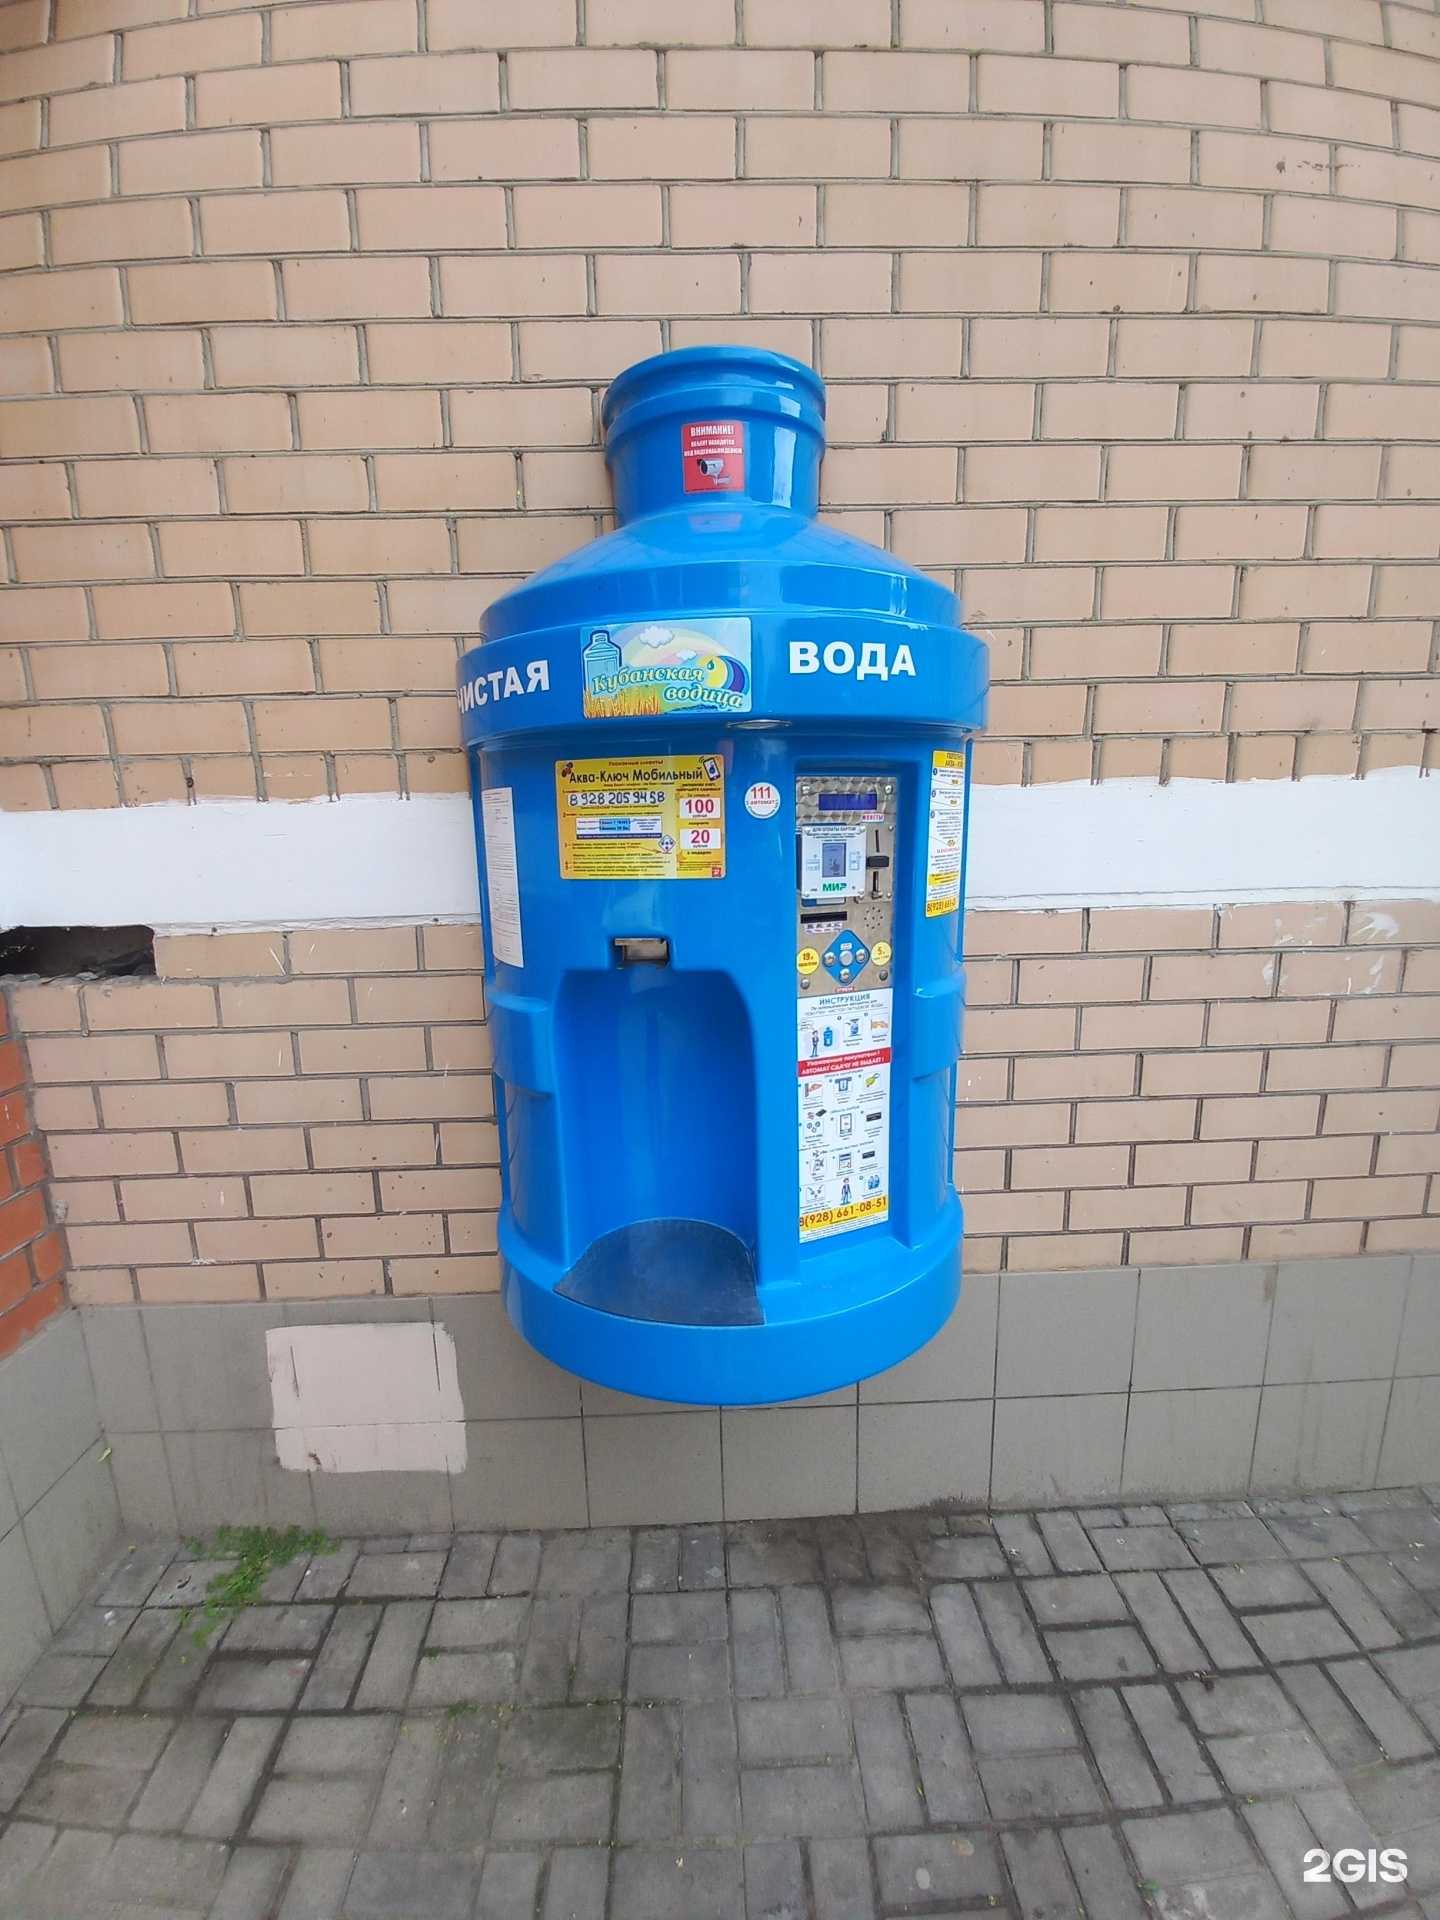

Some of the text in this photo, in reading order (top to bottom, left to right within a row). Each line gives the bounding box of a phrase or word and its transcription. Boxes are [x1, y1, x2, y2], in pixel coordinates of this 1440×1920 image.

[690, 425, 734, 437] ВНИМАНИЕ!
[789, 641, 917, 681] ВОДА
[592, 665, 705, 694] Кубанская
[664, 684, 744, 708] водица
[569, 766, 703, 784] Аква-Ключ Мобильный
[750, 786, 771, 799] 111
[685, 799, 714, 813] 100
[690, 829, 710, 843] 20
[822, 883, 848, 892] МИР
[819, 993, 871, 1006] ИНСТРУКЦИЯ
[799, 1210, 833, 1227] 8(928)
[836, 1196, 887, 1218] 661-08-51
